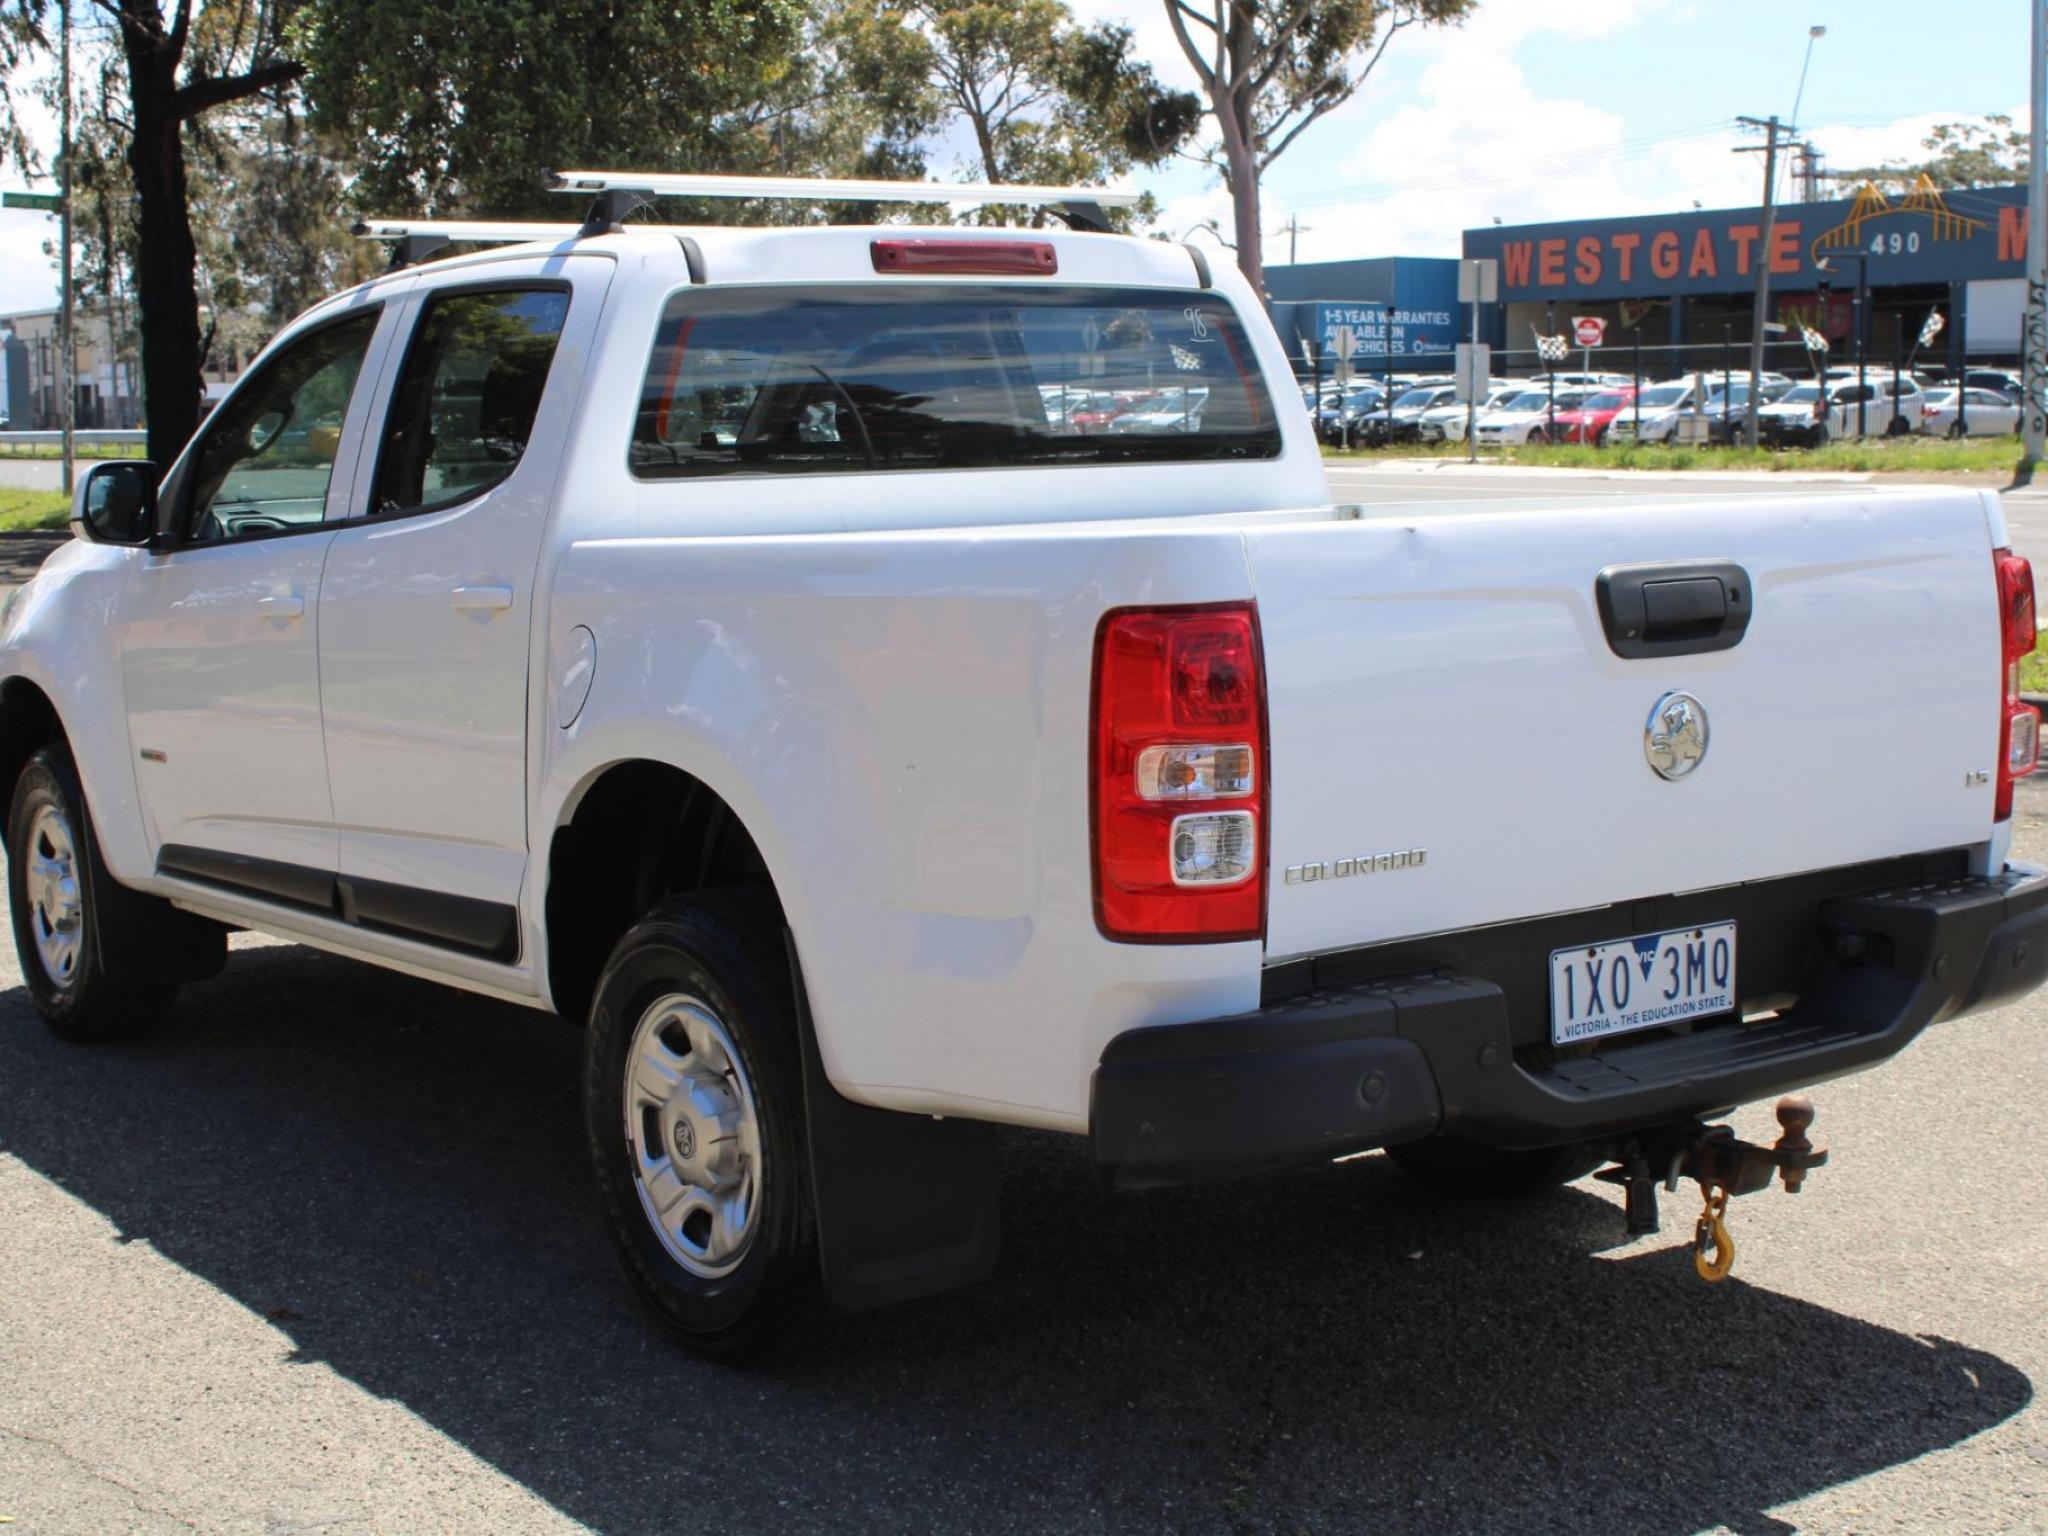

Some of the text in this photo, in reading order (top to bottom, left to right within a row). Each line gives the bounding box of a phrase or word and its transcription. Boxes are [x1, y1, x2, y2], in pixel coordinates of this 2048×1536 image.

[1503, 222, 1800, 288] WESTGATE
[1871, 231, 1920, 255] 490
[1325, 309, 1342, 323] 1-5
[1344, 310, 1374, 324] YEAR
[1358, 340, 1405, 353] EHICLES
[1285, 848, 1427, 884] COLORADO
[1637, 950, 1655, 963] VIC
[1664, 938, 1729, 1000] 3MQ
[1564, 1020, 1611, 1038] VICTORIA
[1620, 1013, 1639, 1026] THE
[1642, 999, 1696, 1021] EDUCATION
[1697, 995, 1726, 1010] STATE
